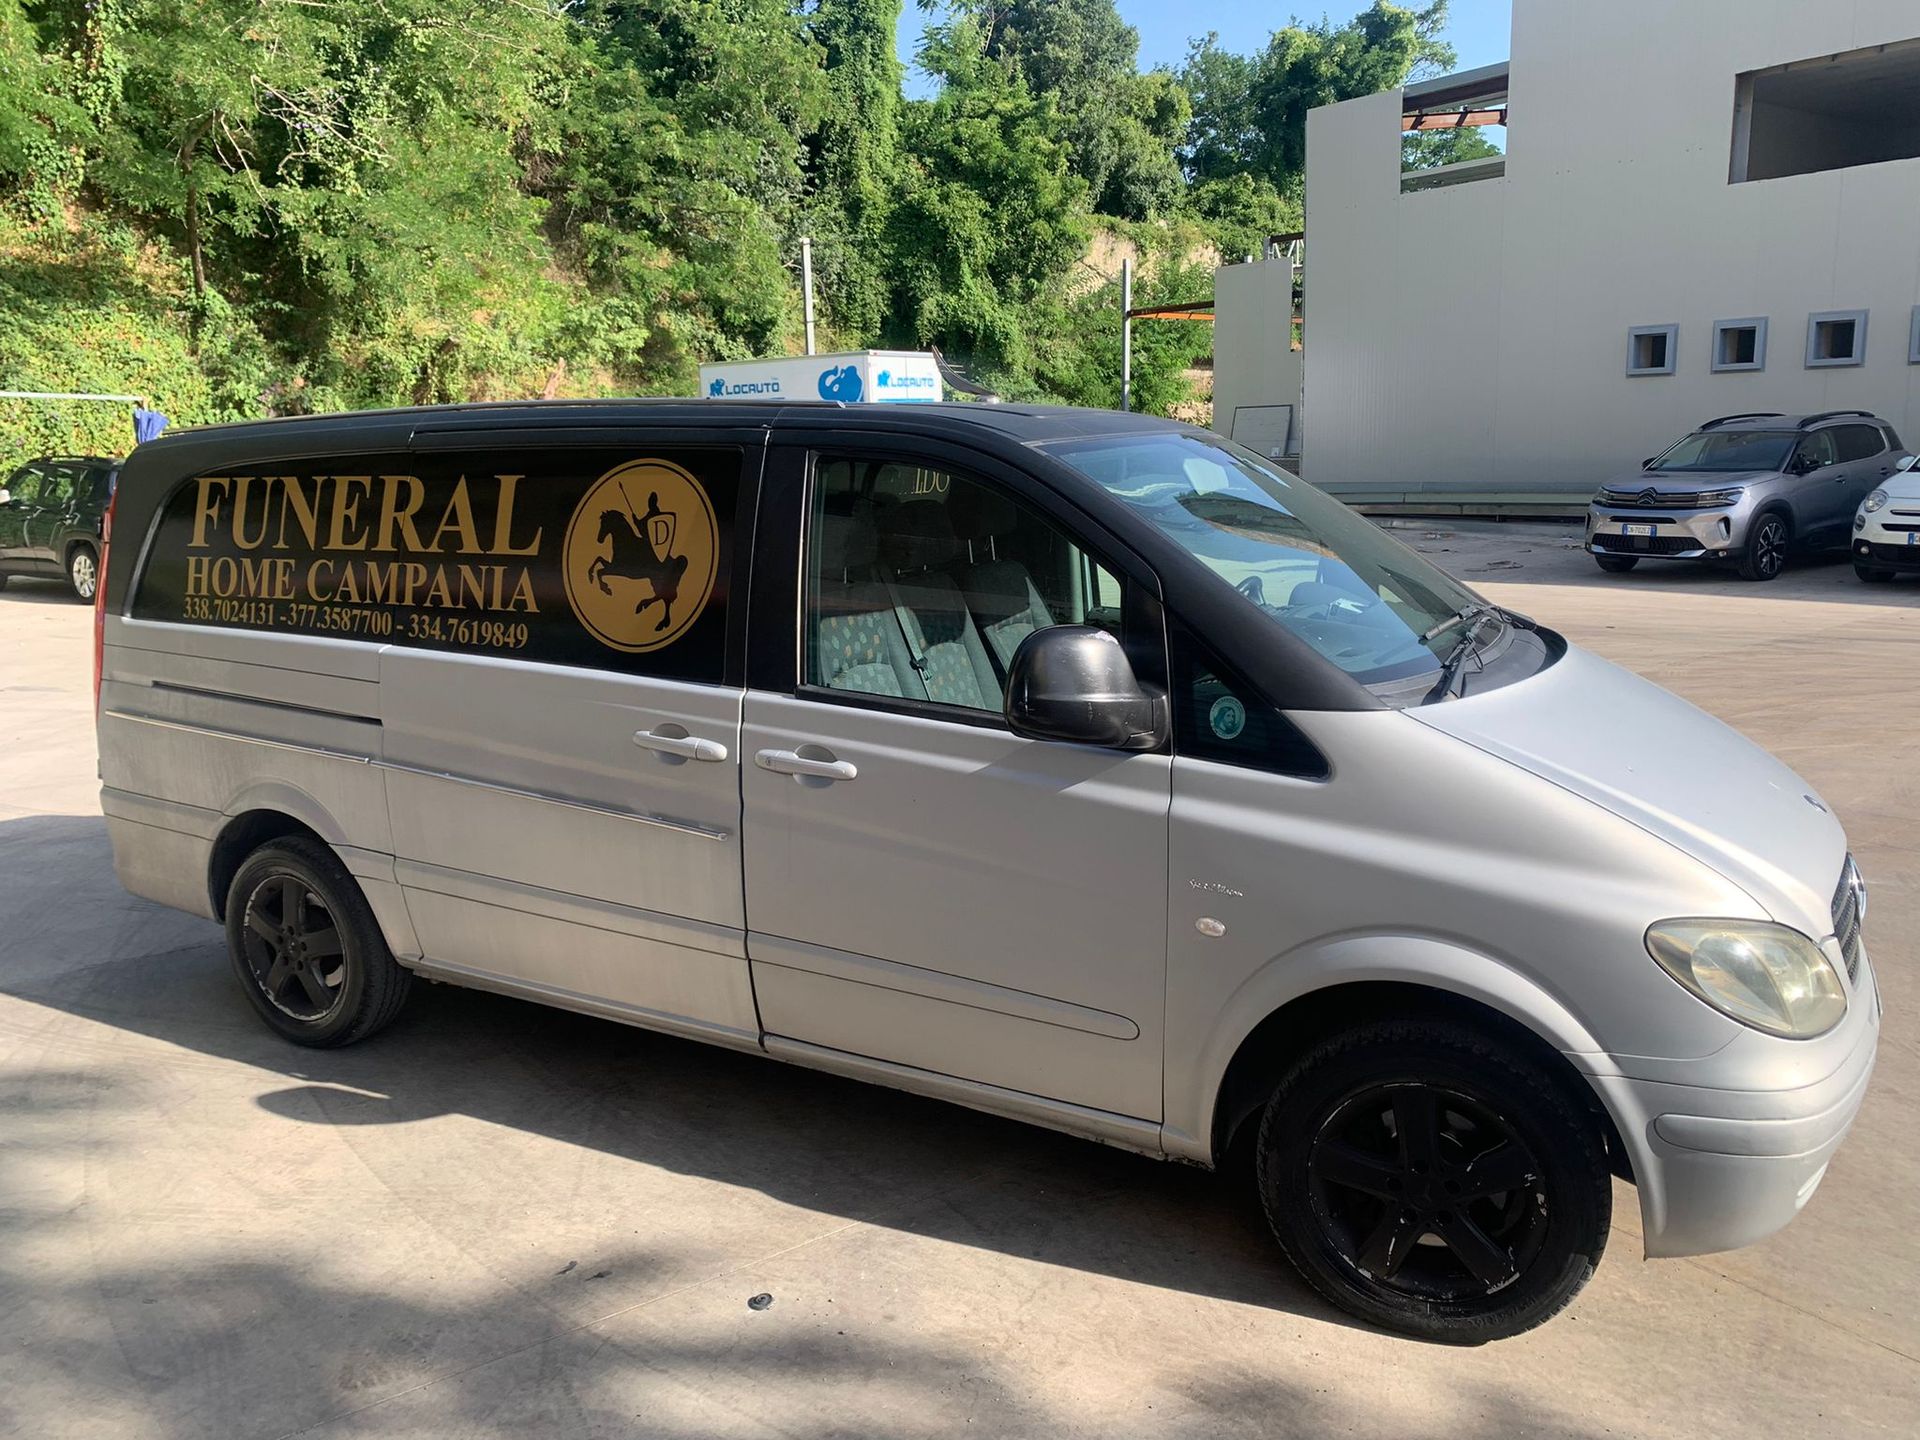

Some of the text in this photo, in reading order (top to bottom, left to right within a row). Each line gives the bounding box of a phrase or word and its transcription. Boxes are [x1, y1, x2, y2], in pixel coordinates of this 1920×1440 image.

[725, 381, 780, 396] LOCAUTO
[890, 376, 935, 388] LOCAUTO
[187, 474, 543, 556] FUNERAL
[653, 519, 670, 546] D
[184, 556, 541, 613] HOME CAMPANIA
[183, 596, 275, 626] 338.7024131
[407, 613, 529, 649] 334.7619849
